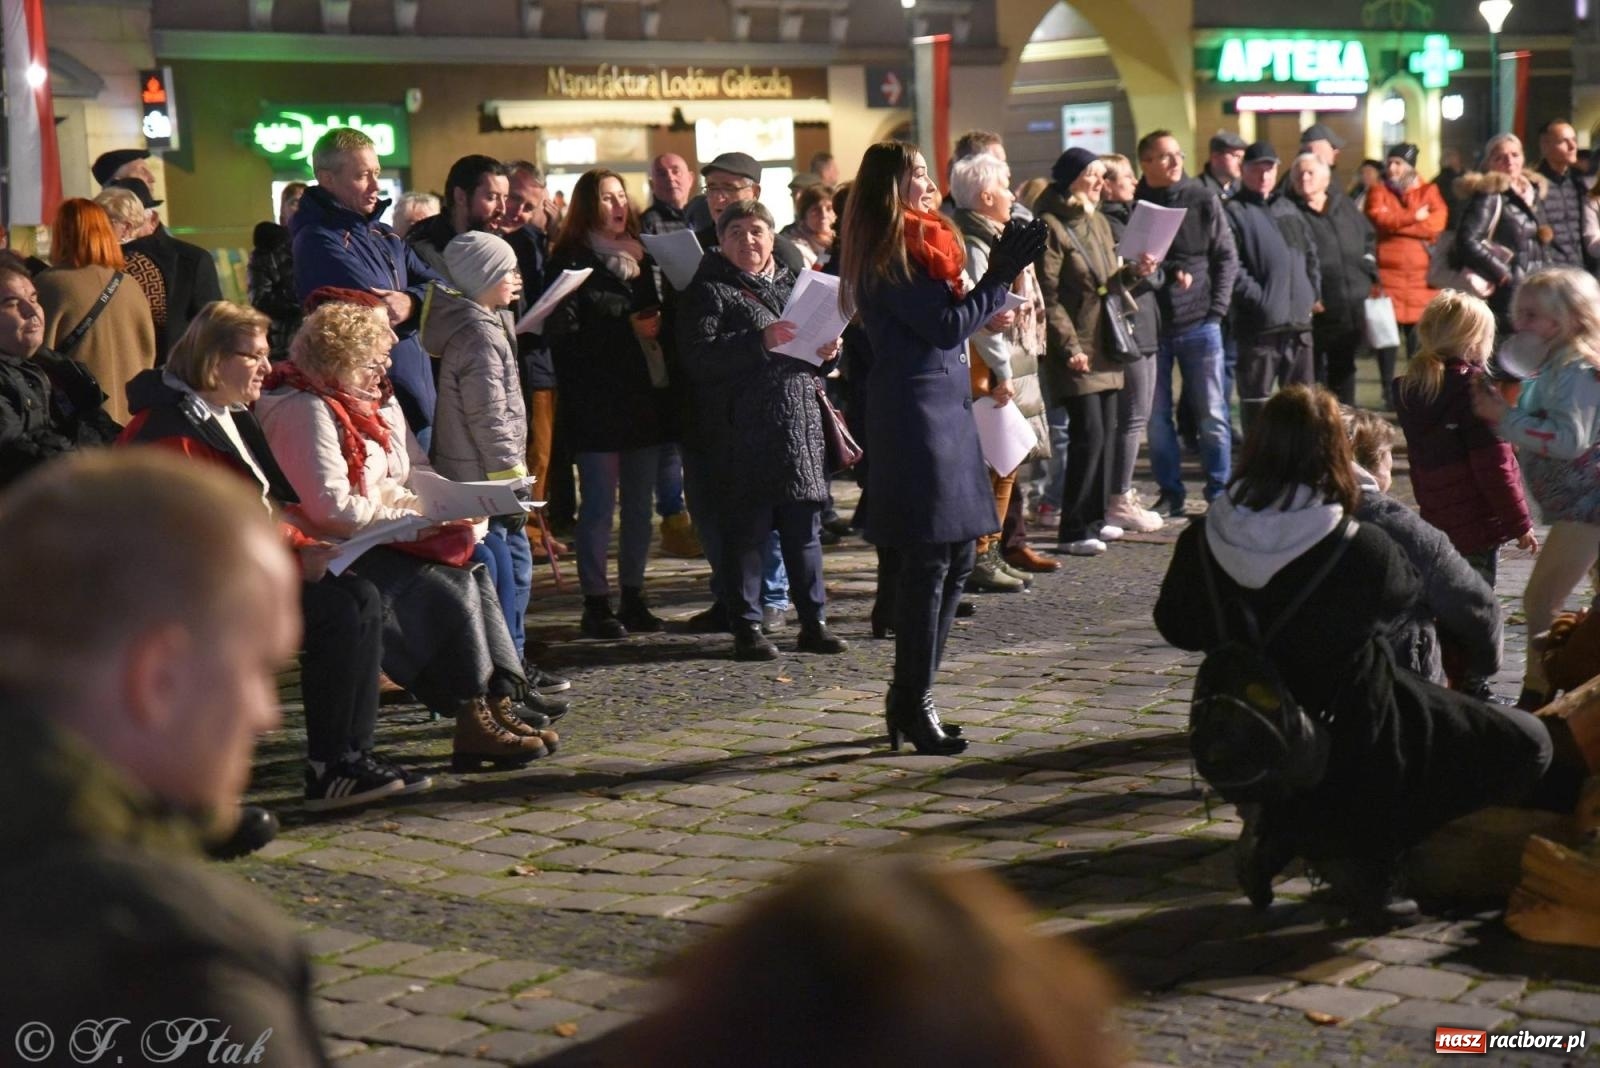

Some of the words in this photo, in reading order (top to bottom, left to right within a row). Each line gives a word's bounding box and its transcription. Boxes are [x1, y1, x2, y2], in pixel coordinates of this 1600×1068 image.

[1218, 39, 1369, 81] APTEKA
[547, 63, 660, 98] Manufaktura
[661, 66, 719, 98] Lodów
